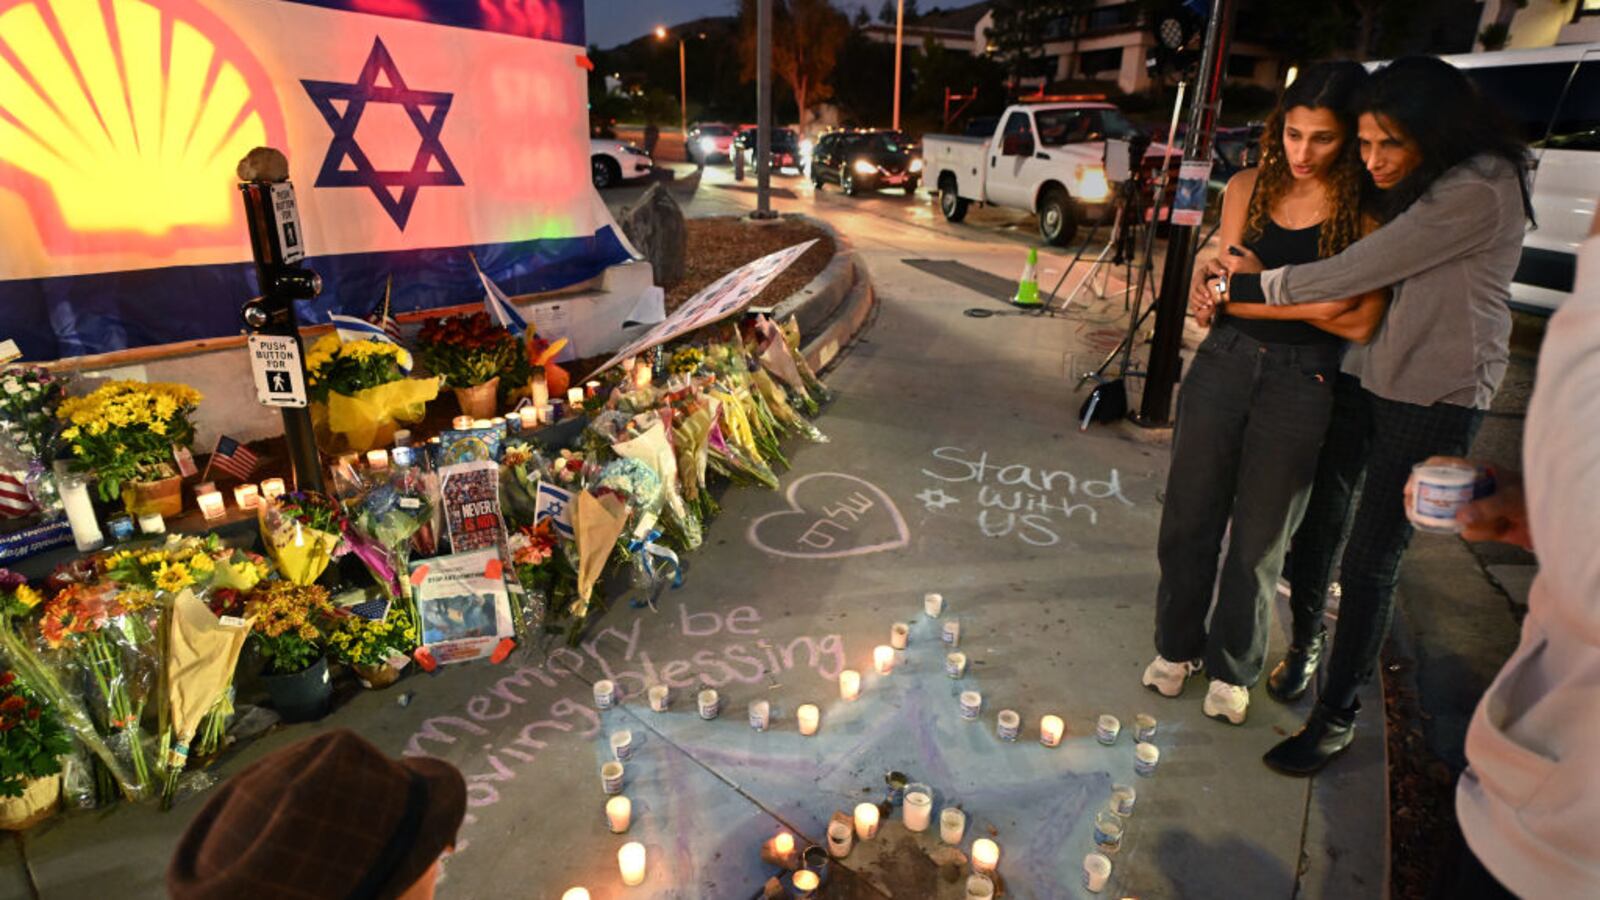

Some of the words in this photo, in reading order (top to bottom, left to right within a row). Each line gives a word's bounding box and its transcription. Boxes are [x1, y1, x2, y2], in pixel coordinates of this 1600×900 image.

[256, 351, 294, 360] BUTTON
[260, 342, 287, 351] PUSH
[266, 360, 286, 368] FOR
[921, 446, 1134, 506] Stand
[461, 500, 493, 518] NEVER
[680, 603, 764, 637] be
[462, 698, 600, 824] oving
[608, 634, 847, 699] blessing
